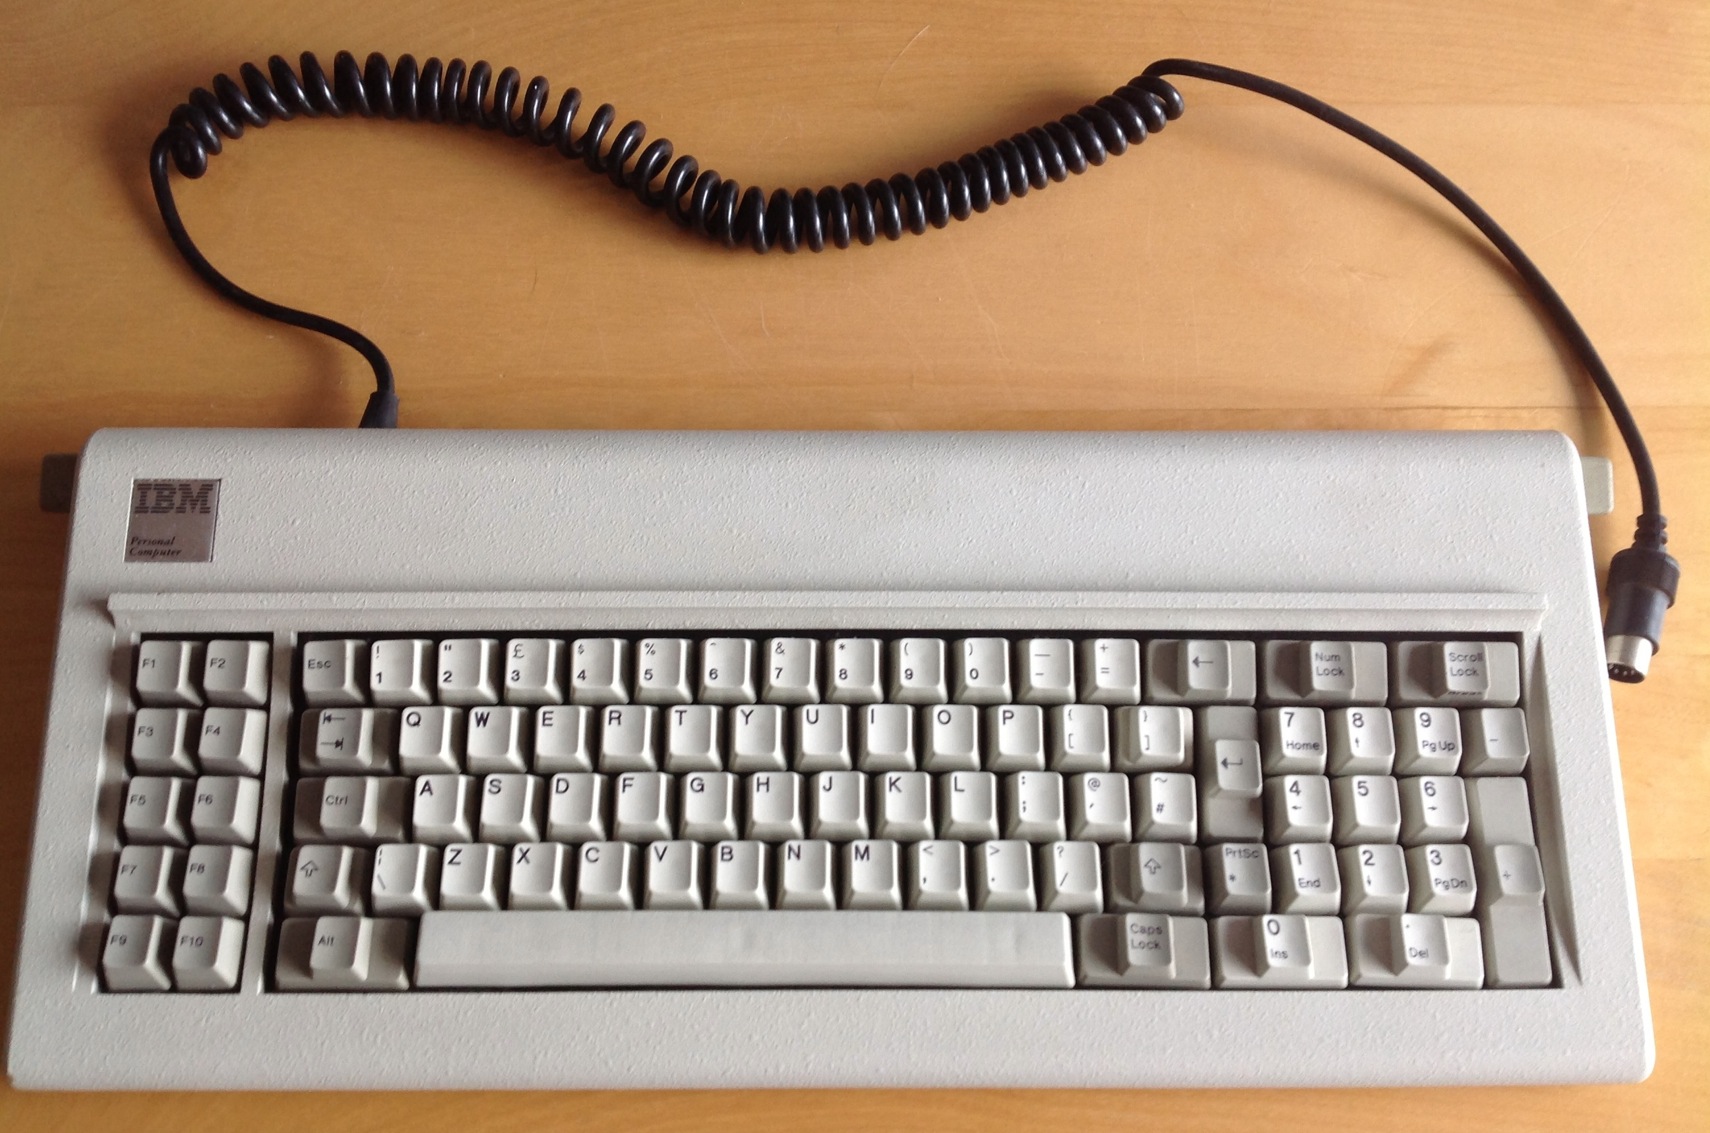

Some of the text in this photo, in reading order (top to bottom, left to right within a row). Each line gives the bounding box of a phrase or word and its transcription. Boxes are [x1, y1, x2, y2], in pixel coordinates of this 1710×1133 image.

[134, 483, 214, 514] IBM
[129, 535, 176, 546] Personal
[128, 547, 182, 559] Computer
[512, 643, 525, 659] £
[577, 643, 585, 656] $
[644, 642, 656, 656] %
[774, 641, 785, 655] &
[903, 642, 909, 656] (
[968, 642, 974, 657] )
[1099, 643, 1109, 653] +
[142, 658, 156, 669] F1
[209, 657, 226, 669] F2
[1314, 651, 1341, 662] Num
[1448, 651, 1485, 663] Scroll
[307, 658, 332, 670] Esc
[1100, 666, 1110, 674] =
[375, 671, 383, 684] 1
[442, 670, 453, 683] 2
[510, 669, 521, 682] 3
[576, 669, 587, 681] 4
[643, 668, 654, 681] 5
[708, 668, 719, 681] 6
[774, 667, 783, 680] 7
[838, 668, 848, 681] 8
[904, 667, 914, 681] 9
[969, 667, 979, 680] 0
[1315, 666, 1345, 677] Lock
[1449, 666, 1480, 677] Lock
[405, 711, 422, 728] Q
[474, 711, 491, 728] W
[541, 710, 554, 727] E
[608, 709, 622, 726] R
[674, 709, 688, 726] T
[740, 709, 755, 726] Y
[805, 708, 819, 725] U
[870, 708, 875, 725] I
[937, 709, 952, 726] O
[1002, 709, 1015, 726] P
[1284, 711, 1295, 728] 7
[1352, 712, 1365, 729] 8
[1419, 711, 1432, 729] 9
[137, 725, 154, 737] F3
[204, 724, 221, 736] F4
[1067, 732, 1075, 750] [
[1144, 734, 1151, 752] ]
[1285, 740, 1322, 753] Home
[488, 778, 502, 795] S
[555, 777, 570, 795] D
[621, 777, 635, 794] F
[689, 776, 705, 793] G
[756, 776, 770, 793] H
[822, 776, 833, 793] J
[888, 776, 902, 793] K
[953, 775, 965, 793] L
[1087, 777, 1101, 792] @
[1154, 776, 1168, 784] ~
[419, 780, 434, 797] A
[1288, 780, 1302, 797] 4
[1357, 780, 1370, 797] 5
[1423, 780, 1437, 798] 6
[129, 794, 146, 806] F5
[197, 793, 213, 805] F6
[325, 794, 348, 806] Ctrl
[1155, 803, 1165, 814] #
[447, 848, 463, 866] Z
[516, 847, 531, 864] X
[584, 846, 600, 864] C
[653, 845, 668, 862] V
[720, 845, 734, 862] B
[787, 844, 801, 861] N
[854, 844, 870, 861] M
[922, 844, 934, 856] <
[989, 845, 1001, 856] >
[1056, 845, 1065, 858] ?
[1293, 848, 1302, 865] 1
[1361, 849, 1376, 867] 2
[1429, 849, 1443, 866] 3
[120, 864, 138, 875] F7
[189, 863, 206, 874] F8
[1502, 870, 1512, 880] +
[376, 873, 387, 891] \
[1059, 872, 1069, 887] /
[1297, 877, 1321, 889] End
[1130, 922, 1163, 936] Caps
[1266, 918, 1281, 936] 0
[109, 934, 128, 946] F9
[179, 935, 204, 947] F10
[317, 935, 335, 946] Alt
[1130, 938, 1161, 951] Lock
[1270, 948, 1289, 960] Ins
[1408, 946, 1429, 959] Del
